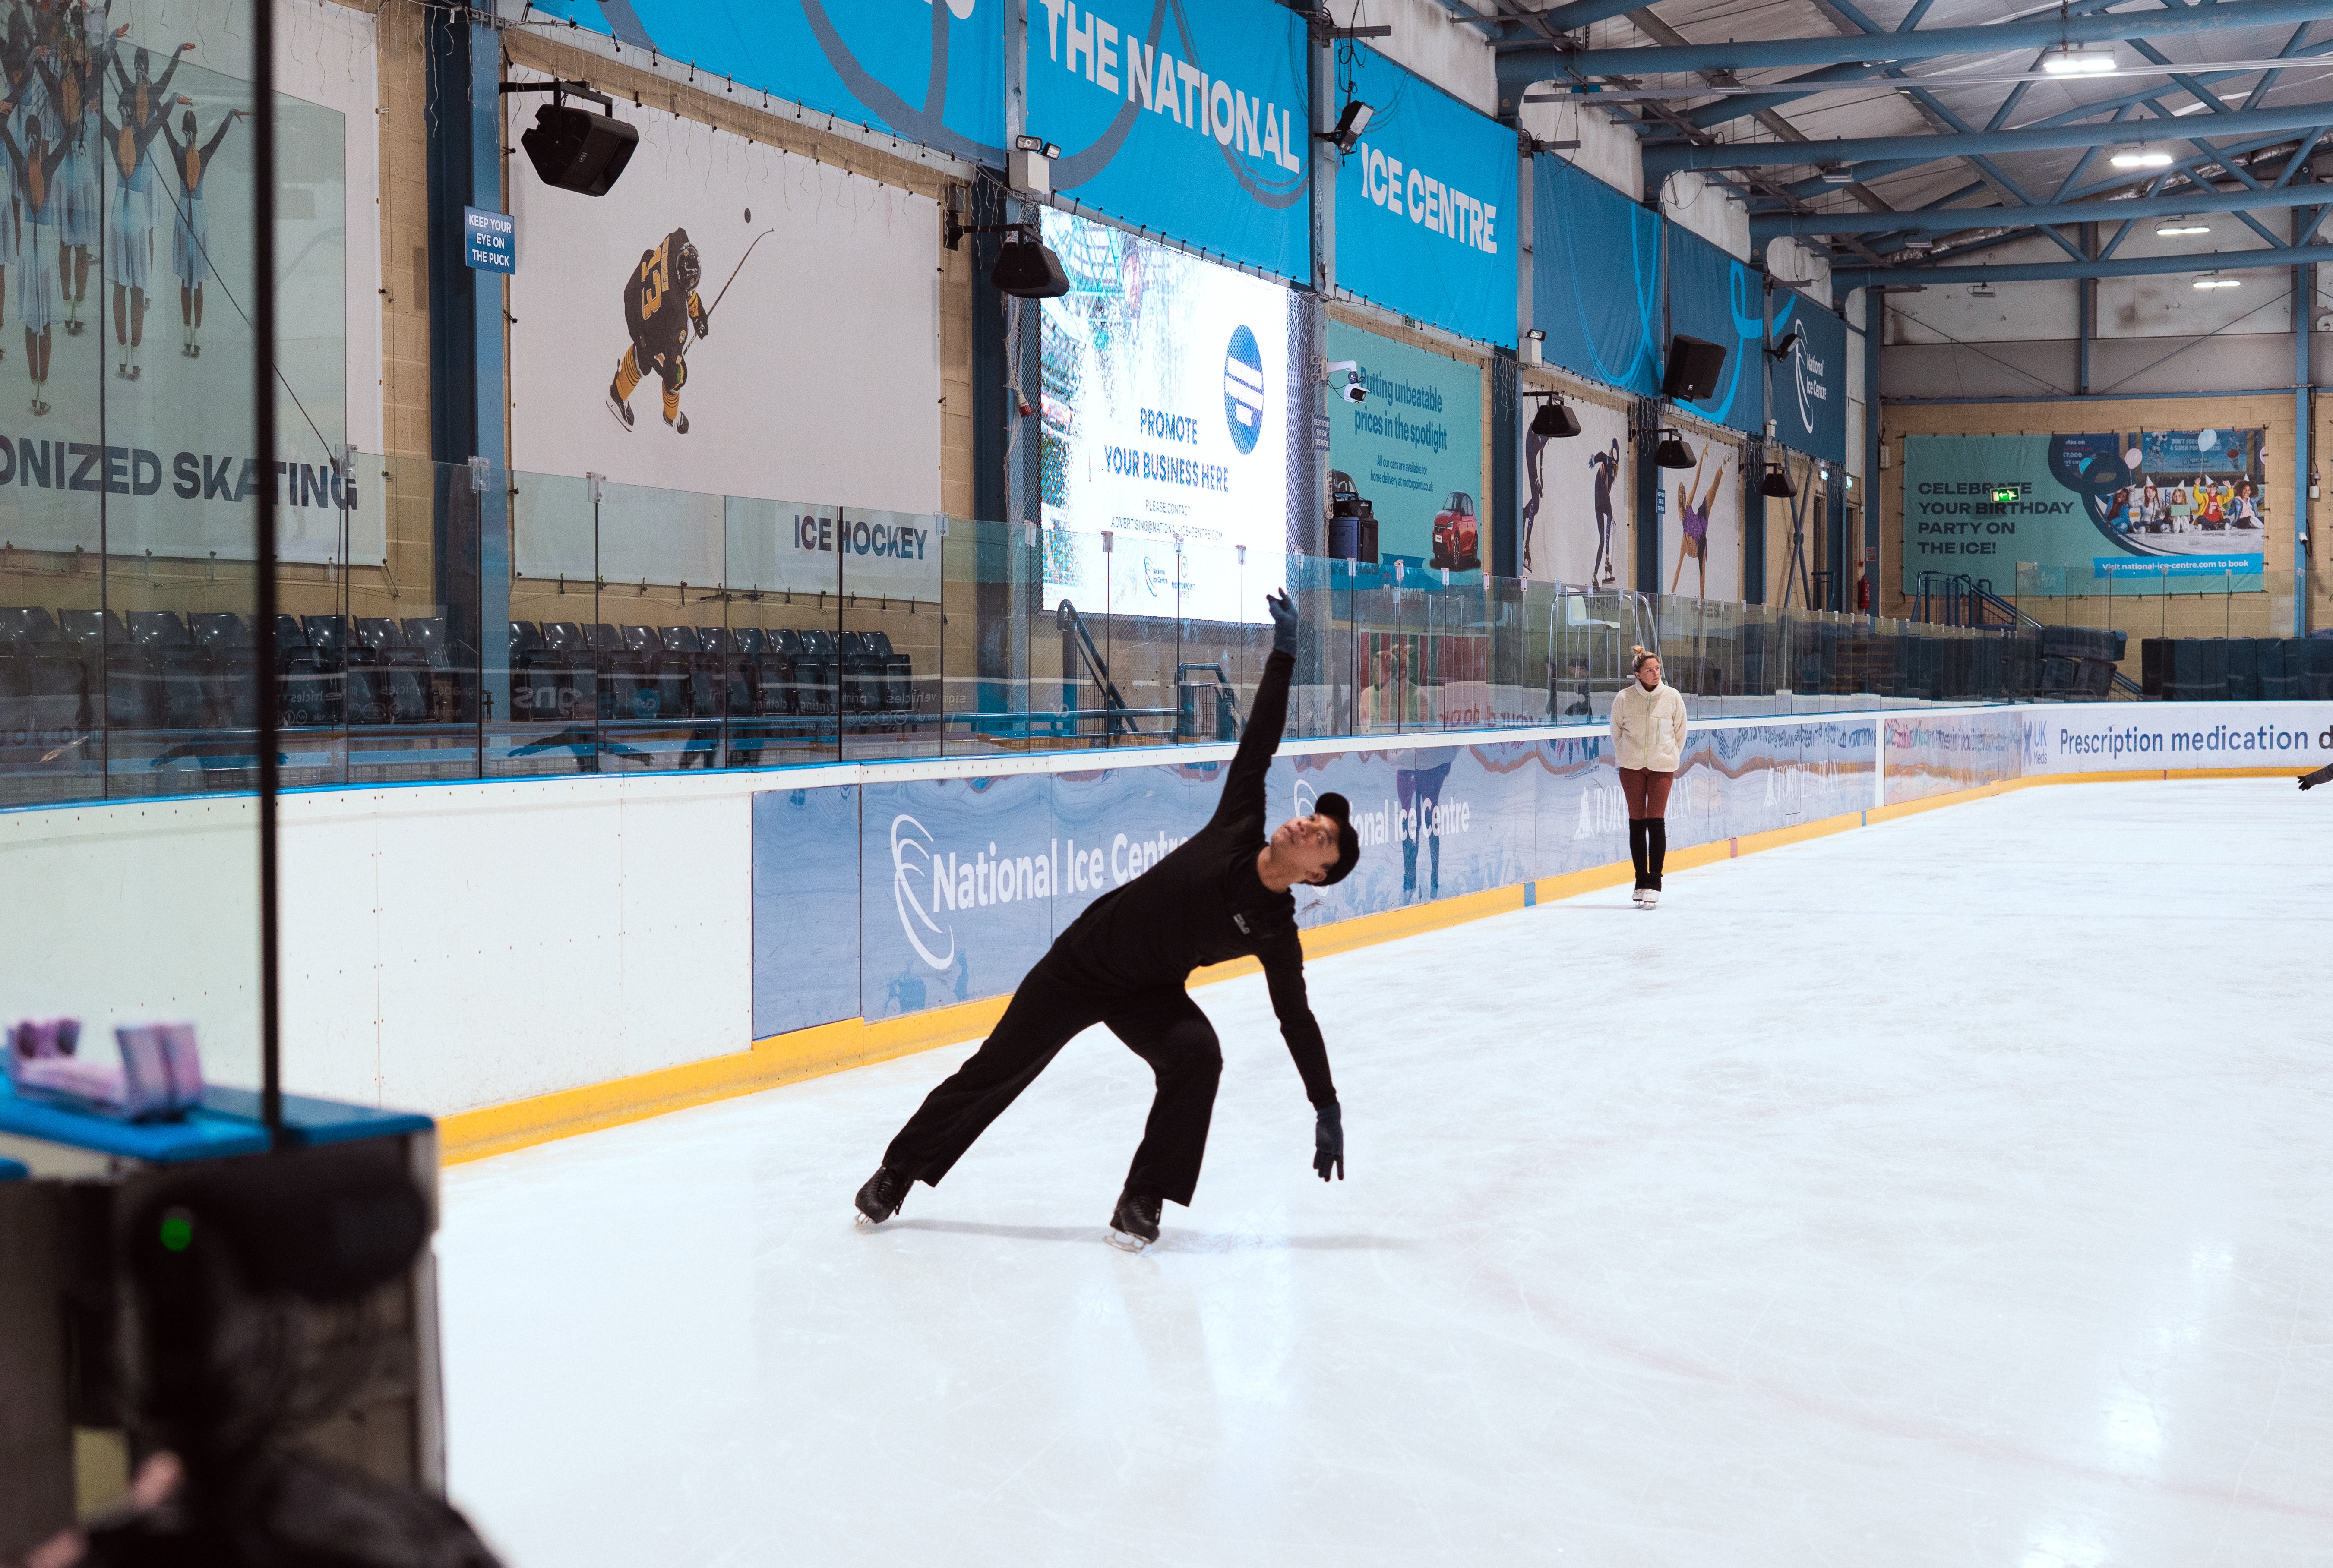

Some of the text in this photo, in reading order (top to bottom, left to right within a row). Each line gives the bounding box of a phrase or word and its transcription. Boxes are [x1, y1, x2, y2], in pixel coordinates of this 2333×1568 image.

[1042, 0, 1299, 174] THE NATIONAL
[1361, 142, 1497, 254] ICE CENTRE
[469, 214, 512, 233] KEEP YOUR
[476, 233, 505, 249] EYE ON
[472, 249, 510, 267] THE PUCK
[1807, 353, 1824, 377] National
[1361, 366, 1442, 413] Putting unbeatable
[1814, 380, 1827, 401] Centre
[1140, 407, 1198, 445] PROMOTE
[1355, 405, 1447, 454] prices in the spotlight
[1104, 445, 1228, 492] YOUR BUSINESS HERE
[1370, 469, 1381, 483] home
[1382, 472, 1398, 488] delivery
[1390, 461, 1398, 470] cars
[1405, 461, 1422, 474] available
[1146, 499, 1191, 516] PLEASE CONTACT
[1919, 502, 2074, 515] YOUR BIRTHDAY
[794, 515, 928, 560] ICE HOCKEY
[1918, 522, 2015, 534] PARTY ON
[1917, 542, 1997, 554] THE ICE!
[2121, 560, 2216, 570] national-ice-centre.com
[2228, 559, 2249, 568] book
[2034, 721, 2047, 748] UK
[2061, 725, 2333, 760] Prescription medication d
[2034, 750, 2048, 766] Meds
[1350, 797, 1470, 847] ional Ice Centre
[933, 838, 1058, 913] National
[1067, 839, 1105, 893] Ice
